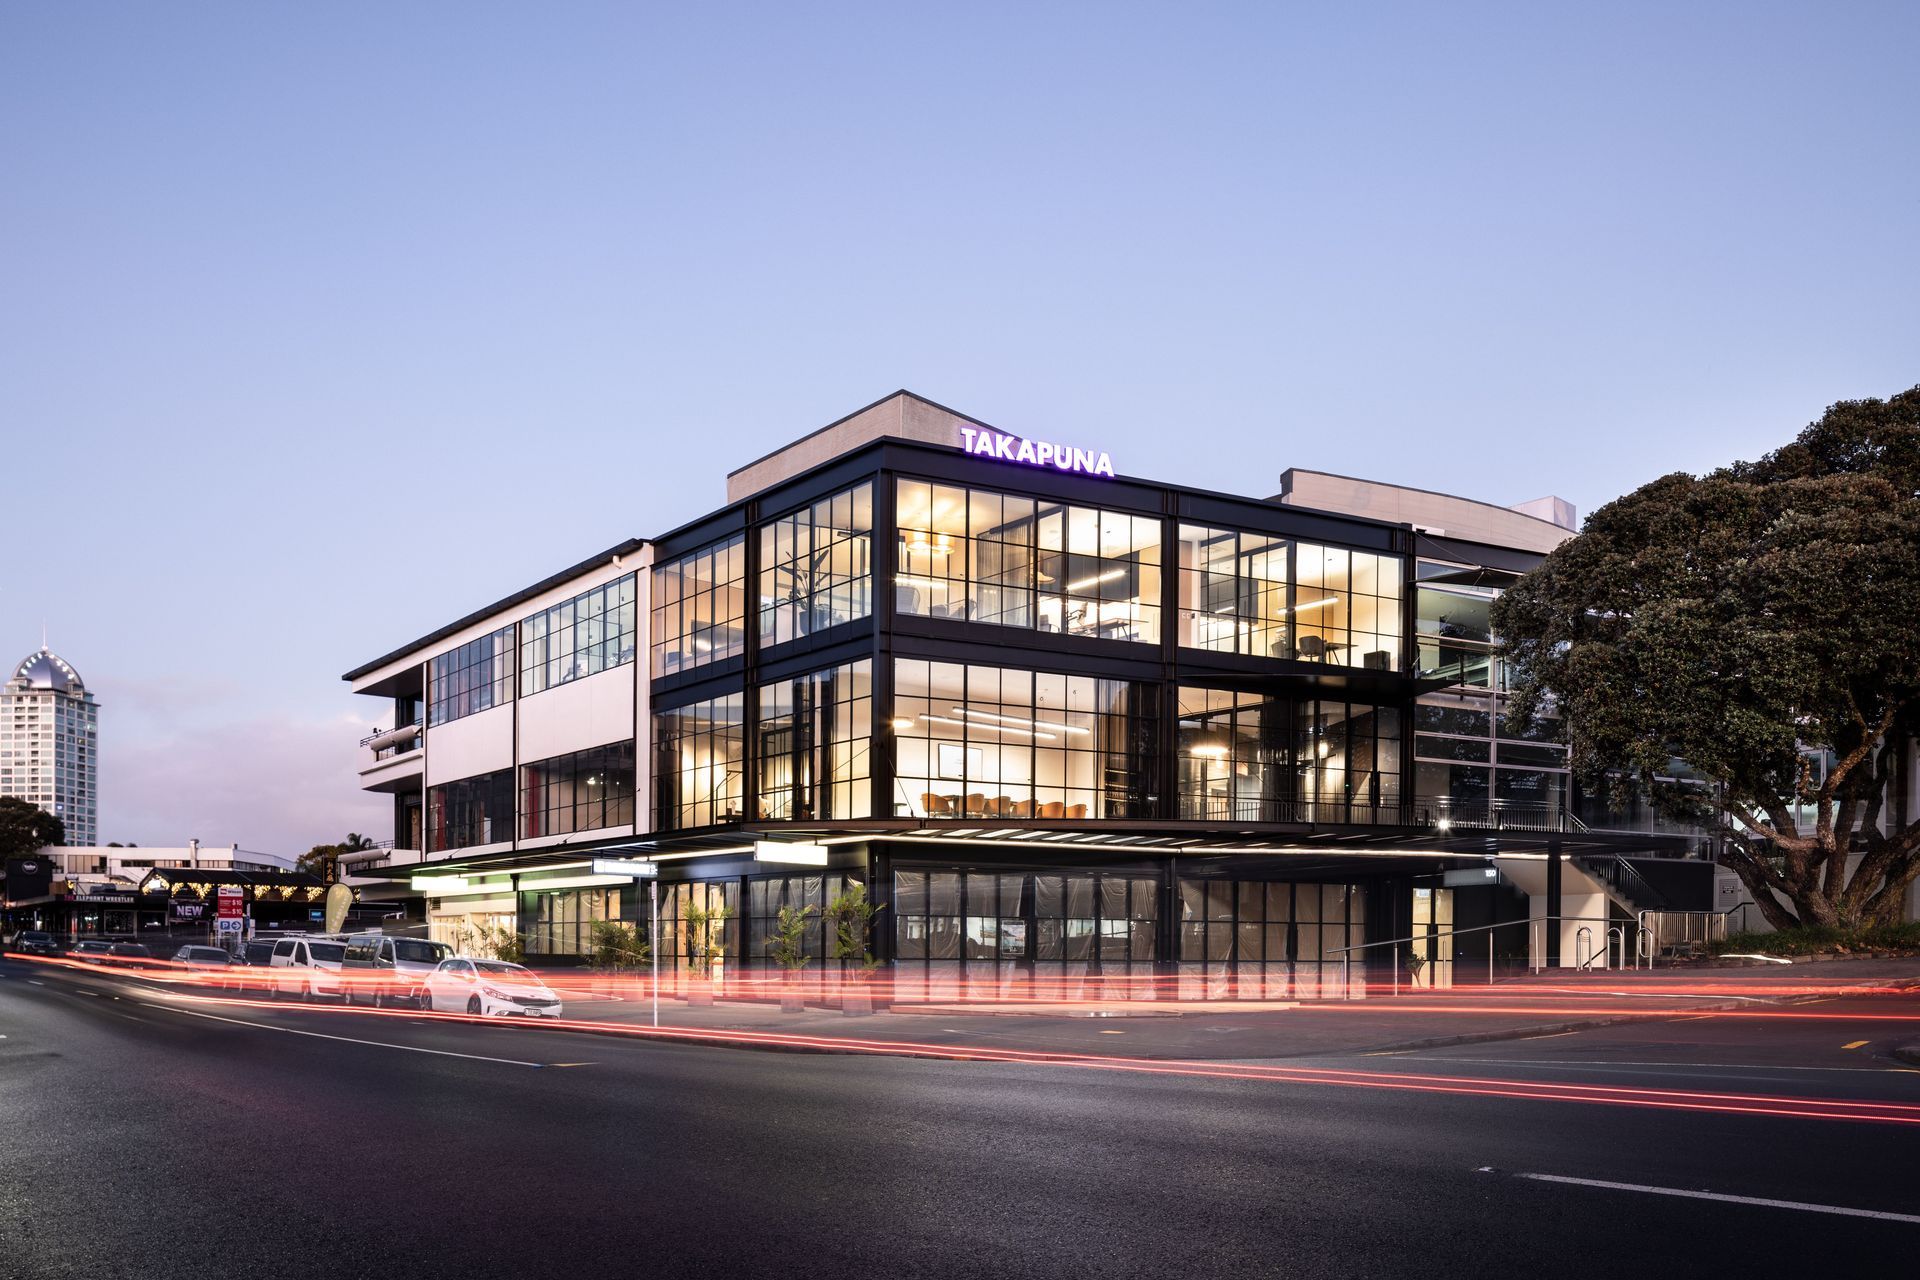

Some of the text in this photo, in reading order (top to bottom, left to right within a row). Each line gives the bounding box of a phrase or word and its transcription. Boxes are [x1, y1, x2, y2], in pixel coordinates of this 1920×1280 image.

[961, 427, 1115, 477] TAKAPUNA
[1485, 869, 1496, 877] 150
[176, 905, 203, 916] NEW
